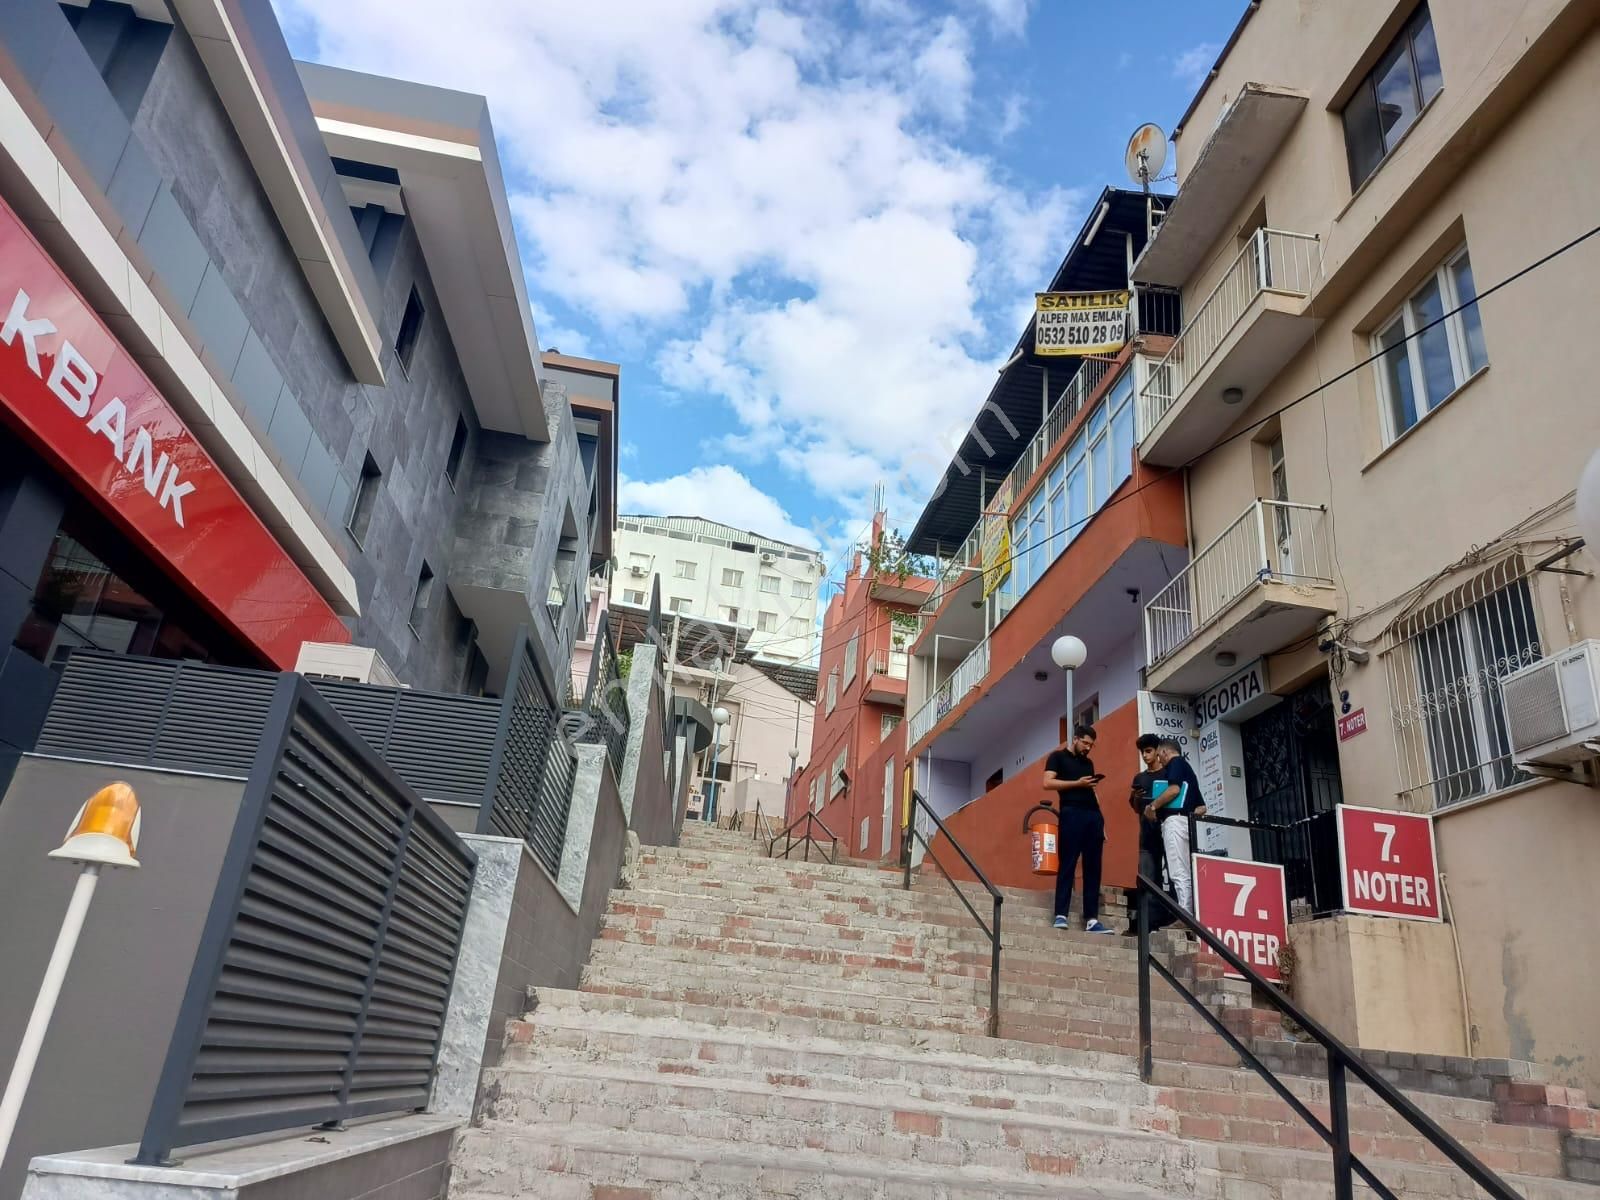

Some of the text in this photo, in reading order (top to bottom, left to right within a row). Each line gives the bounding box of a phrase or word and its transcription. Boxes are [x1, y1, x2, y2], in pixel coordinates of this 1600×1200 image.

[1041, 293, 1124, 308] SATILIK
[1040, 311, 1123, 324] ALPER MAX EMLAK
[1037, 324, 1124, 345] 0532 510 28 09
[1195, 670, 1261, 729] SİGORTA
[1155, 717, 1184, 729] DASK
[1346, 713, 1365, 732] NOTER
[1373, 822, 1400, 864] 7.
[1224, 872, 1268, 920] 7.
[1352, 869, 1431, 908] NOTER
